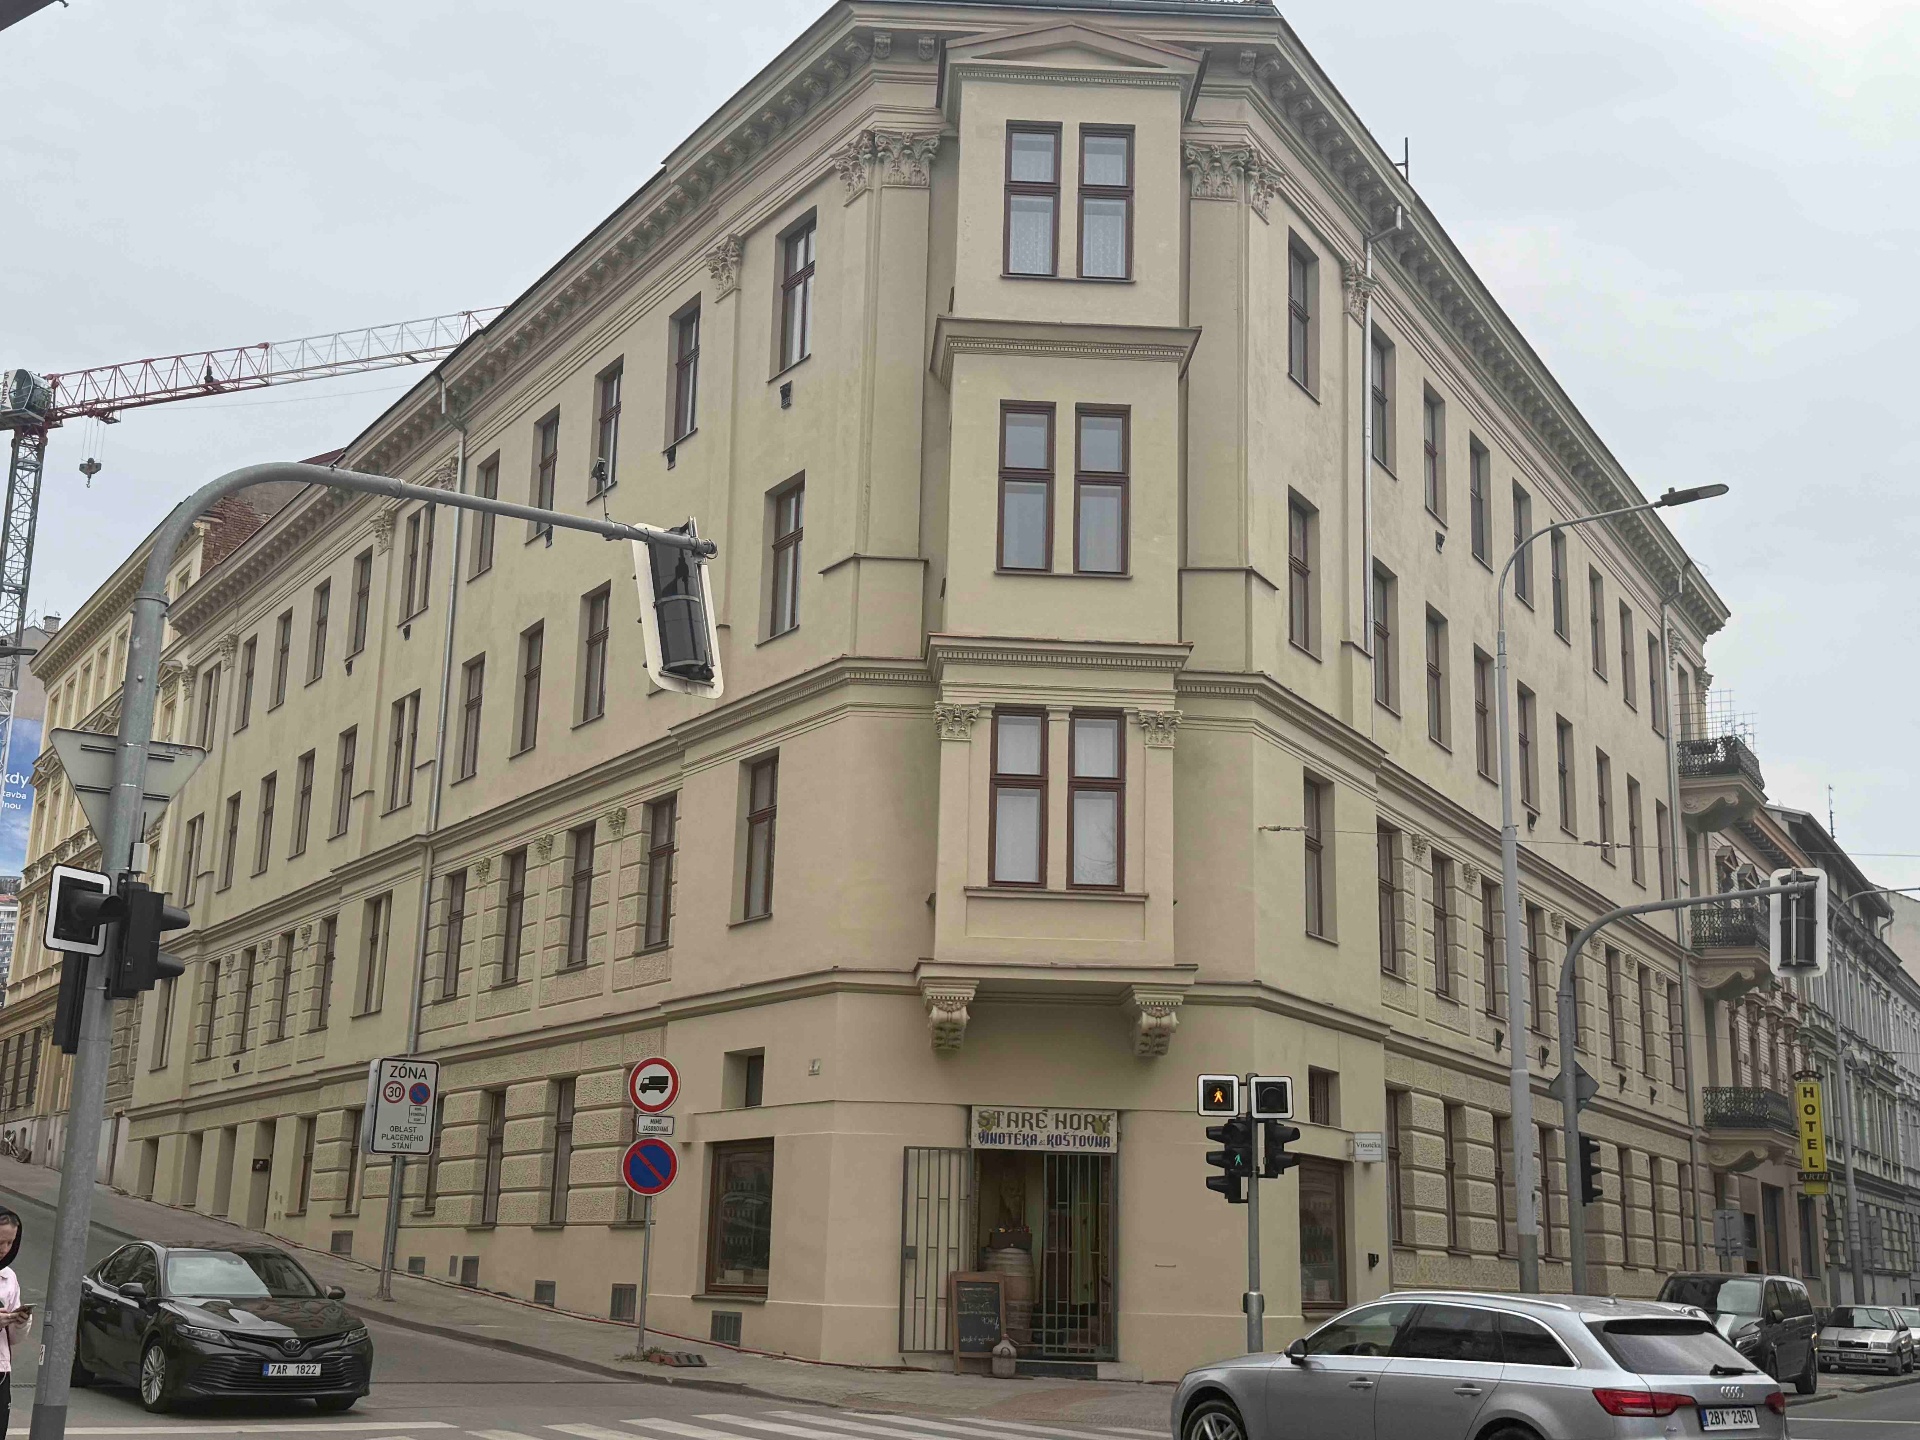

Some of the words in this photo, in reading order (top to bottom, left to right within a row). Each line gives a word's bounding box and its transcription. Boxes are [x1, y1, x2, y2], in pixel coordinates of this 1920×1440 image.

[390, 1063, 428, 1080] ZÓNA
[387, 1086, 401, 1098] 30
[977, 1109, 1049, 1131] STARÉ
[1055, 1112, 1112, 1134] HORY
[1803, 1087, 1818, 1168] HOTEL
[389, 1125, 418, 1133] OBLAST
[381, 1133, 424, 1142] PLACENÉHO
[978, 1130, 1038, 1147] VINOTÉKA
[1046, 1132, 1111, 1148] KOŠTOVNA
[391, 1142, 412, 1150] STÁNÍ
[270, 1364, 288, 1375] 7AR
[295, 1364, 317, 1375] 1822
[1708, 1411, 1727, 1425] 2BX
[1731, 1410, 1754, 1424] 2350
